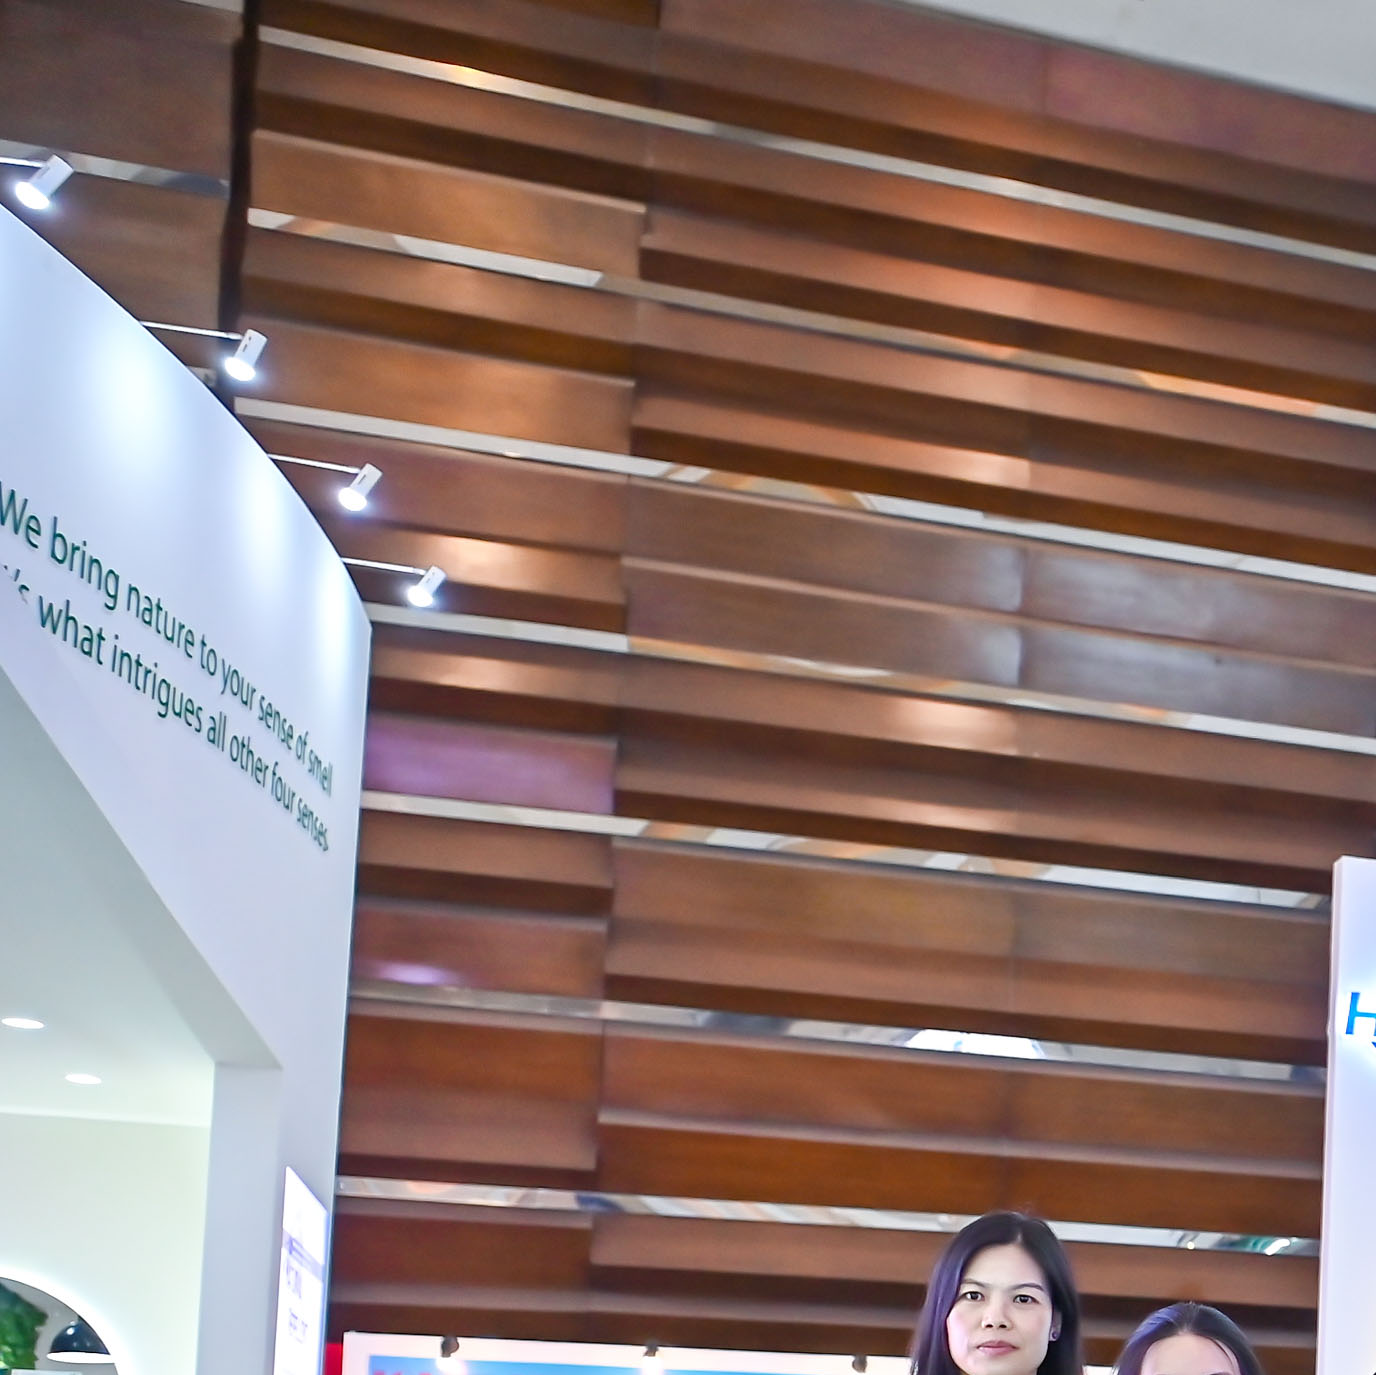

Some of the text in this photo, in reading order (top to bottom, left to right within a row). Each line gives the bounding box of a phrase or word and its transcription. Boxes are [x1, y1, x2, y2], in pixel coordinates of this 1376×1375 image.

[0, 480, 42, 550] We
[50, 516, 120, 612] bring
[128, 585, 195, 660] nature
[200, 635, 218, 678] to
[220, 656, 257, 711] your
[258, 694, 294, 749] sense
[295, 730, 308, 763] of
[308, 747, 333, 798] smell
[38, 594, 330, 853] what intrigues all other four senses
